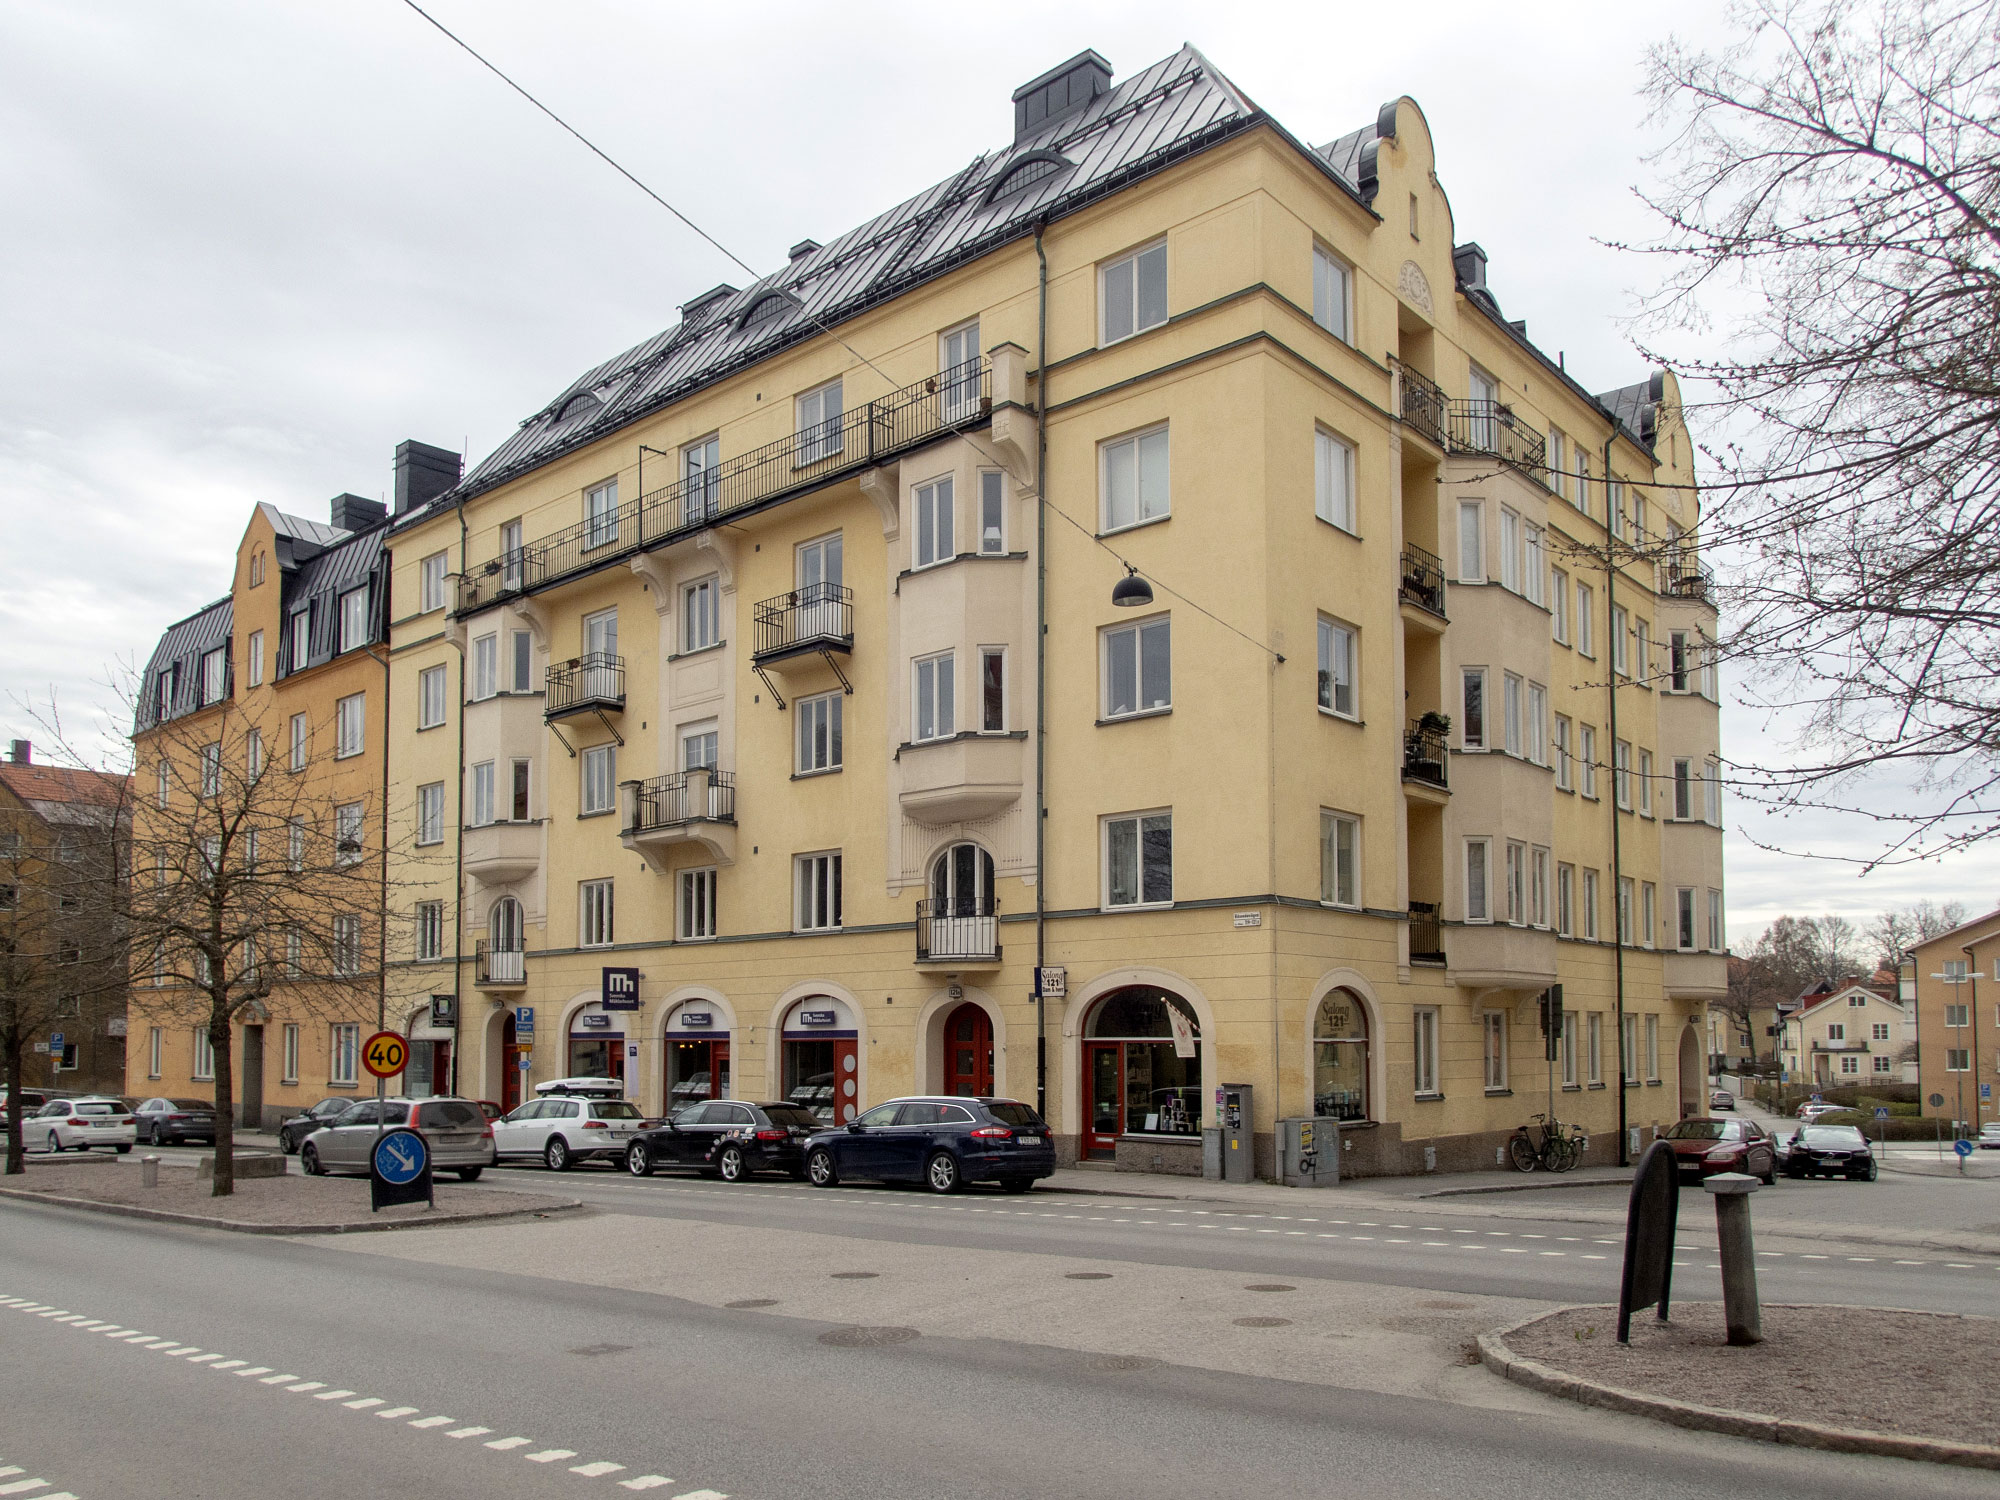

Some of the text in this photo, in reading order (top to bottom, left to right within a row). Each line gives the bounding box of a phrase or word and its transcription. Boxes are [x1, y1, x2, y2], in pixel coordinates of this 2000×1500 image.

[1042, 970, 1064, 984] Salong
[521, 1008, 530, 1021] P
[1322, 1001, 1350, 1021] Salong
[1328, 1014, 1344, 1027] 121
[370, 1043, 402, 1066] 40
